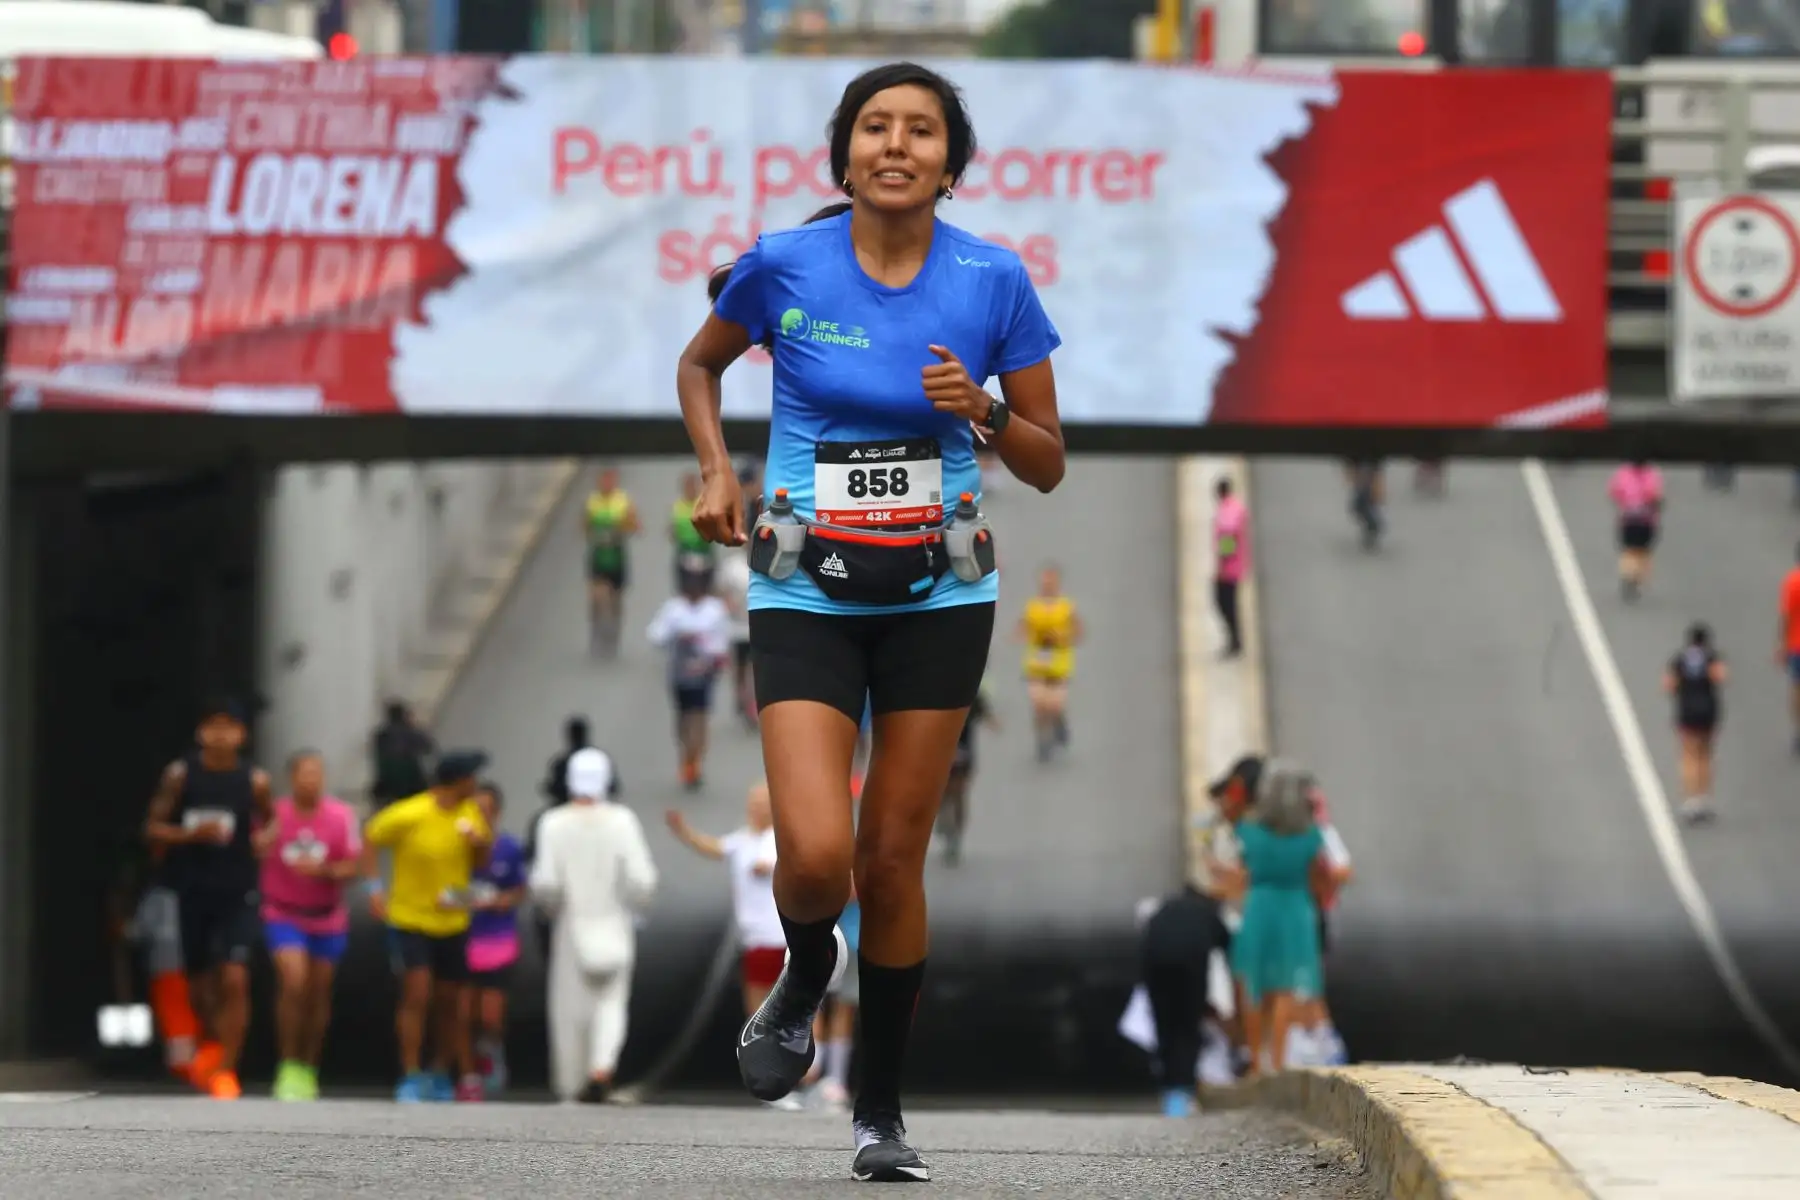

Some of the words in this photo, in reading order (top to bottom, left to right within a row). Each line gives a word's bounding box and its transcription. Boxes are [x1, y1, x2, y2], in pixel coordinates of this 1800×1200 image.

[755, 144, 850, 212] po
[206, 152, 440, 236] LORENA
[812, 320, 840, 333] LIFE
[811, 331, 871, 348] RUNNERS
[847, 467, 909, 498] 858
[866, 511, 892, 521] 42K
